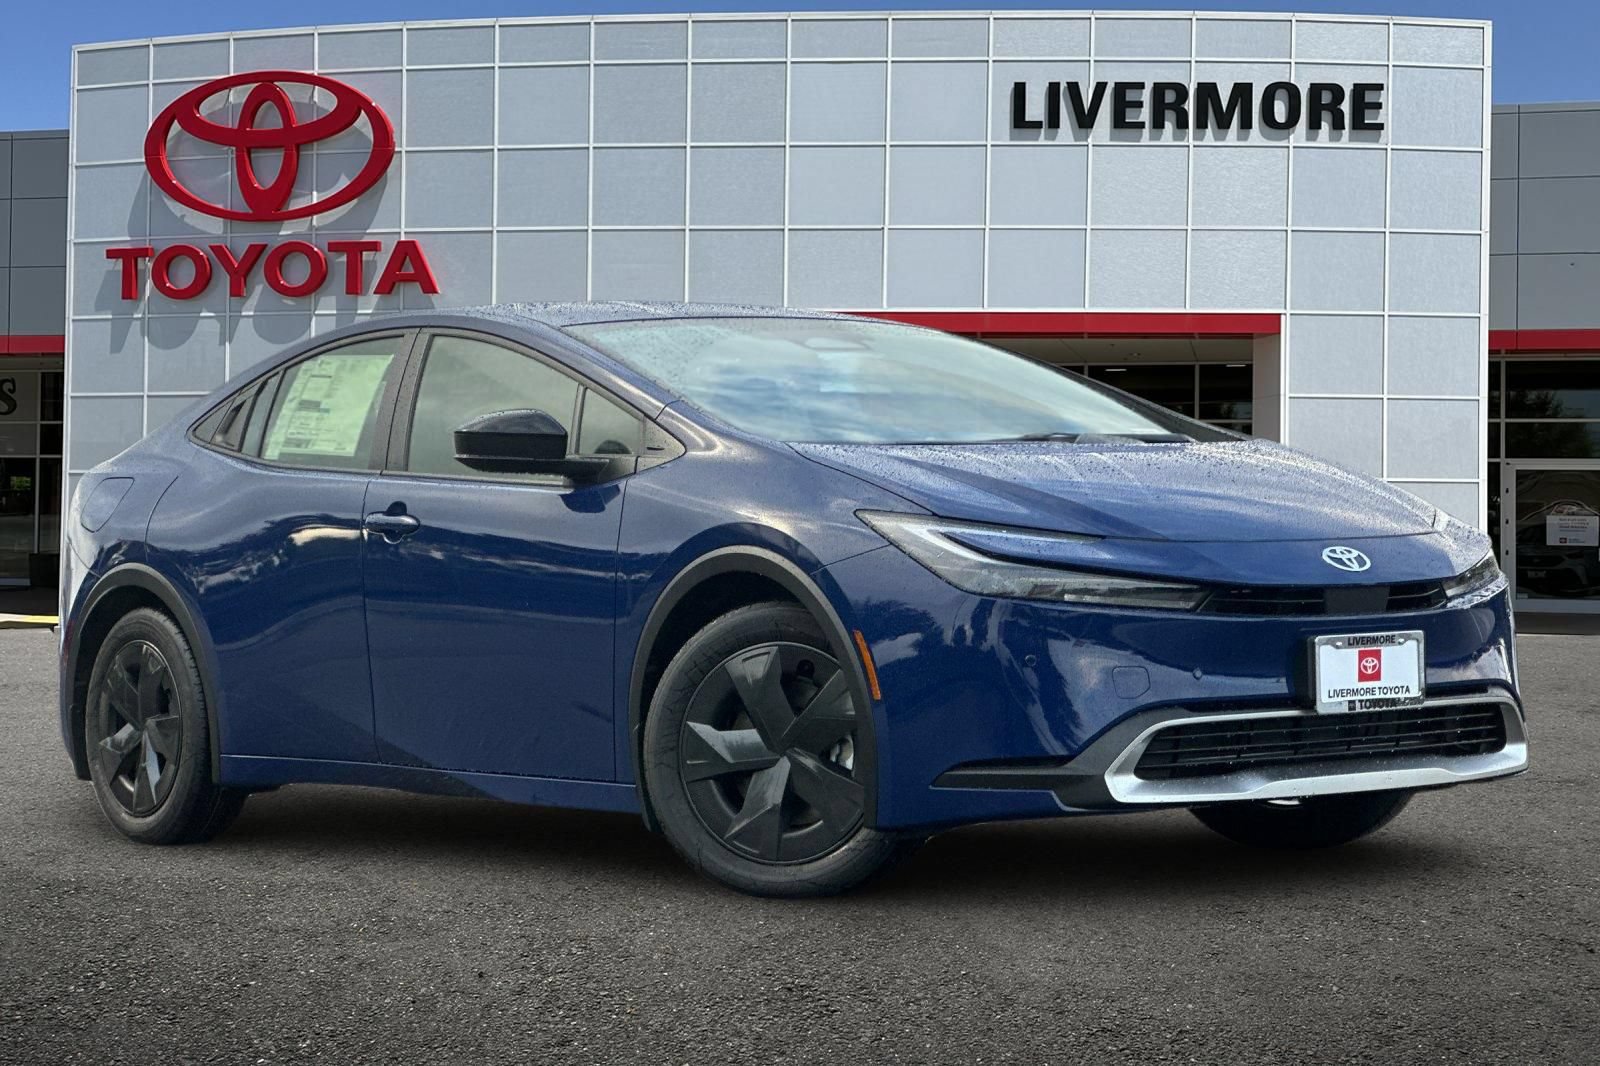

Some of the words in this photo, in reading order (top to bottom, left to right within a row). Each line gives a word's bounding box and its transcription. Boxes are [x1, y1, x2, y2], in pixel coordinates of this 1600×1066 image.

[1013, 81, 1384, 131] LIVERMORE
[105, 240, 441, 300] TOYOTA
[1347, 635, 1395, 646] LIVERMORE
[1328, 687, 1376, 698] LIVERMORE
[1378, 685, 1410, 695] TOYOTA
